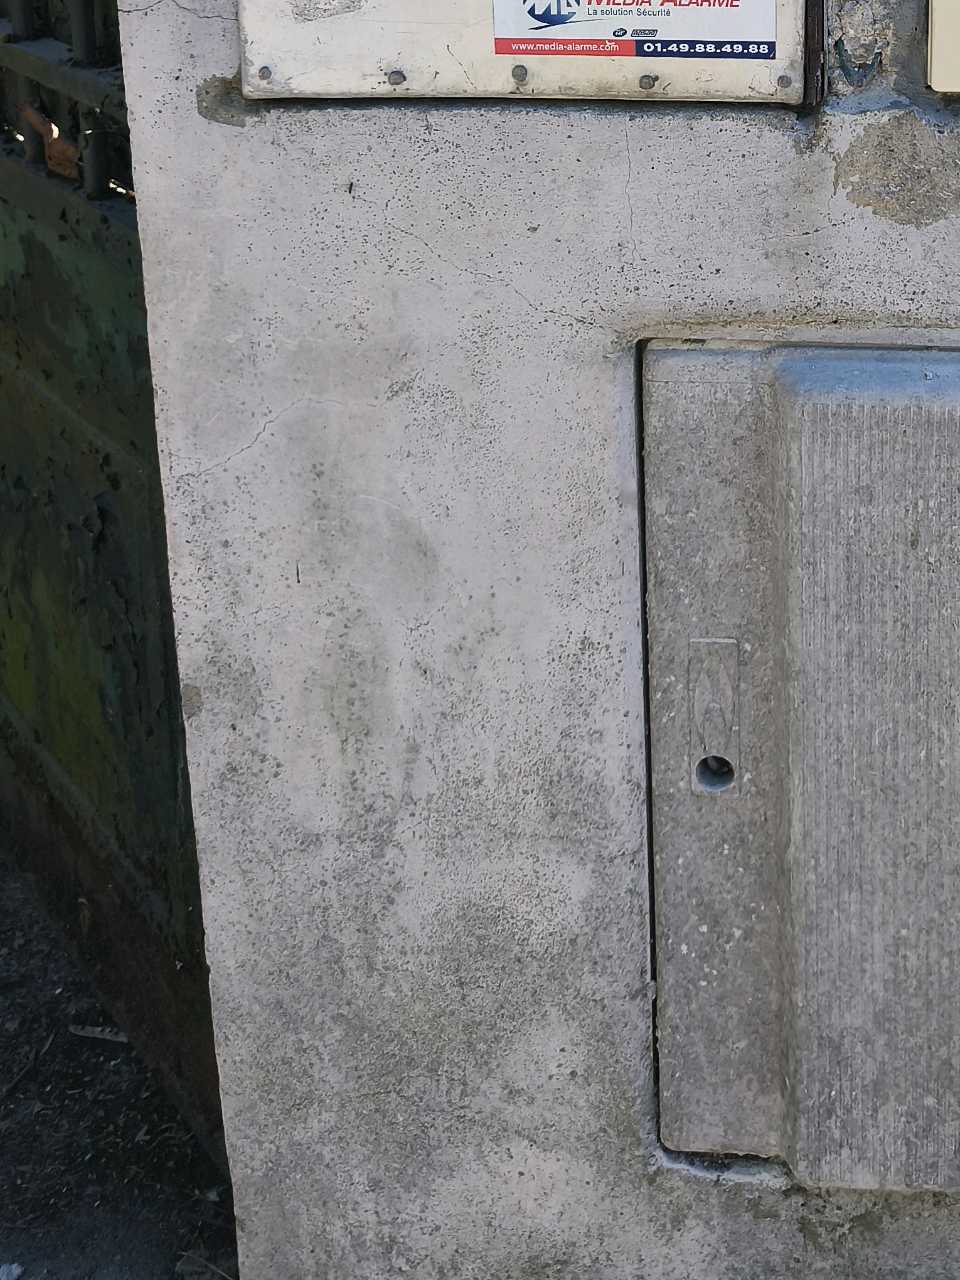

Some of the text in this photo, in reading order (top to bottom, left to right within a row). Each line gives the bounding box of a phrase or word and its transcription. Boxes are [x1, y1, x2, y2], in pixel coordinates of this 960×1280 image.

[587, 7, 671, 18] La solution Sécurité
[511, 40, 620, 53] www.media-alarme.com
[643, 42, 769, 55] 01.49.88.49.88
